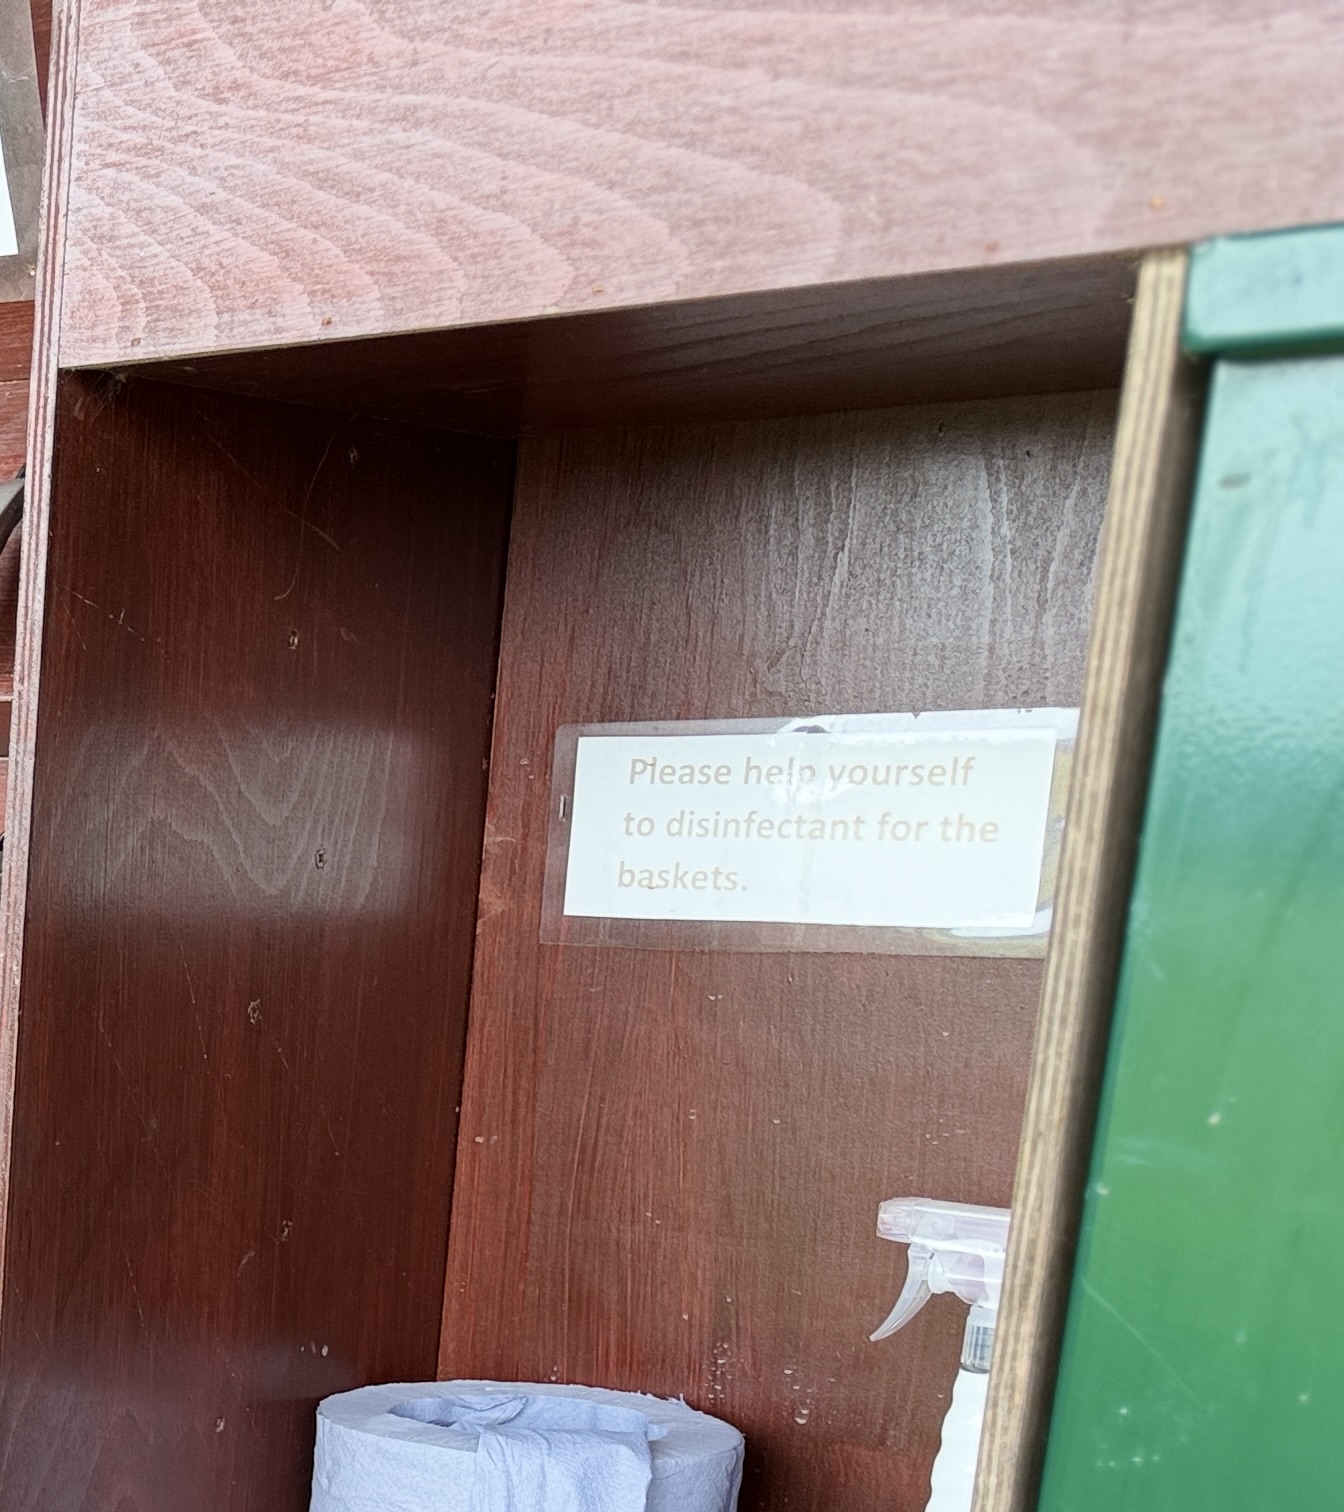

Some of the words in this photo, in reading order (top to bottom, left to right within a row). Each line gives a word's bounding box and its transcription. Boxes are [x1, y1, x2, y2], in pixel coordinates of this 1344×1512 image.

[628, 755, 733, 787] Please
[743, 756, 817, 792] help
[827, 756, 976, 793] yourself
[623, 812, 655, 838] to
[665, 810, 866, 843] disinfectant
[876, 811, 929, 844] for
[938, 812, 1001, 845] the
[616, 861, 749, 893] baskets.
